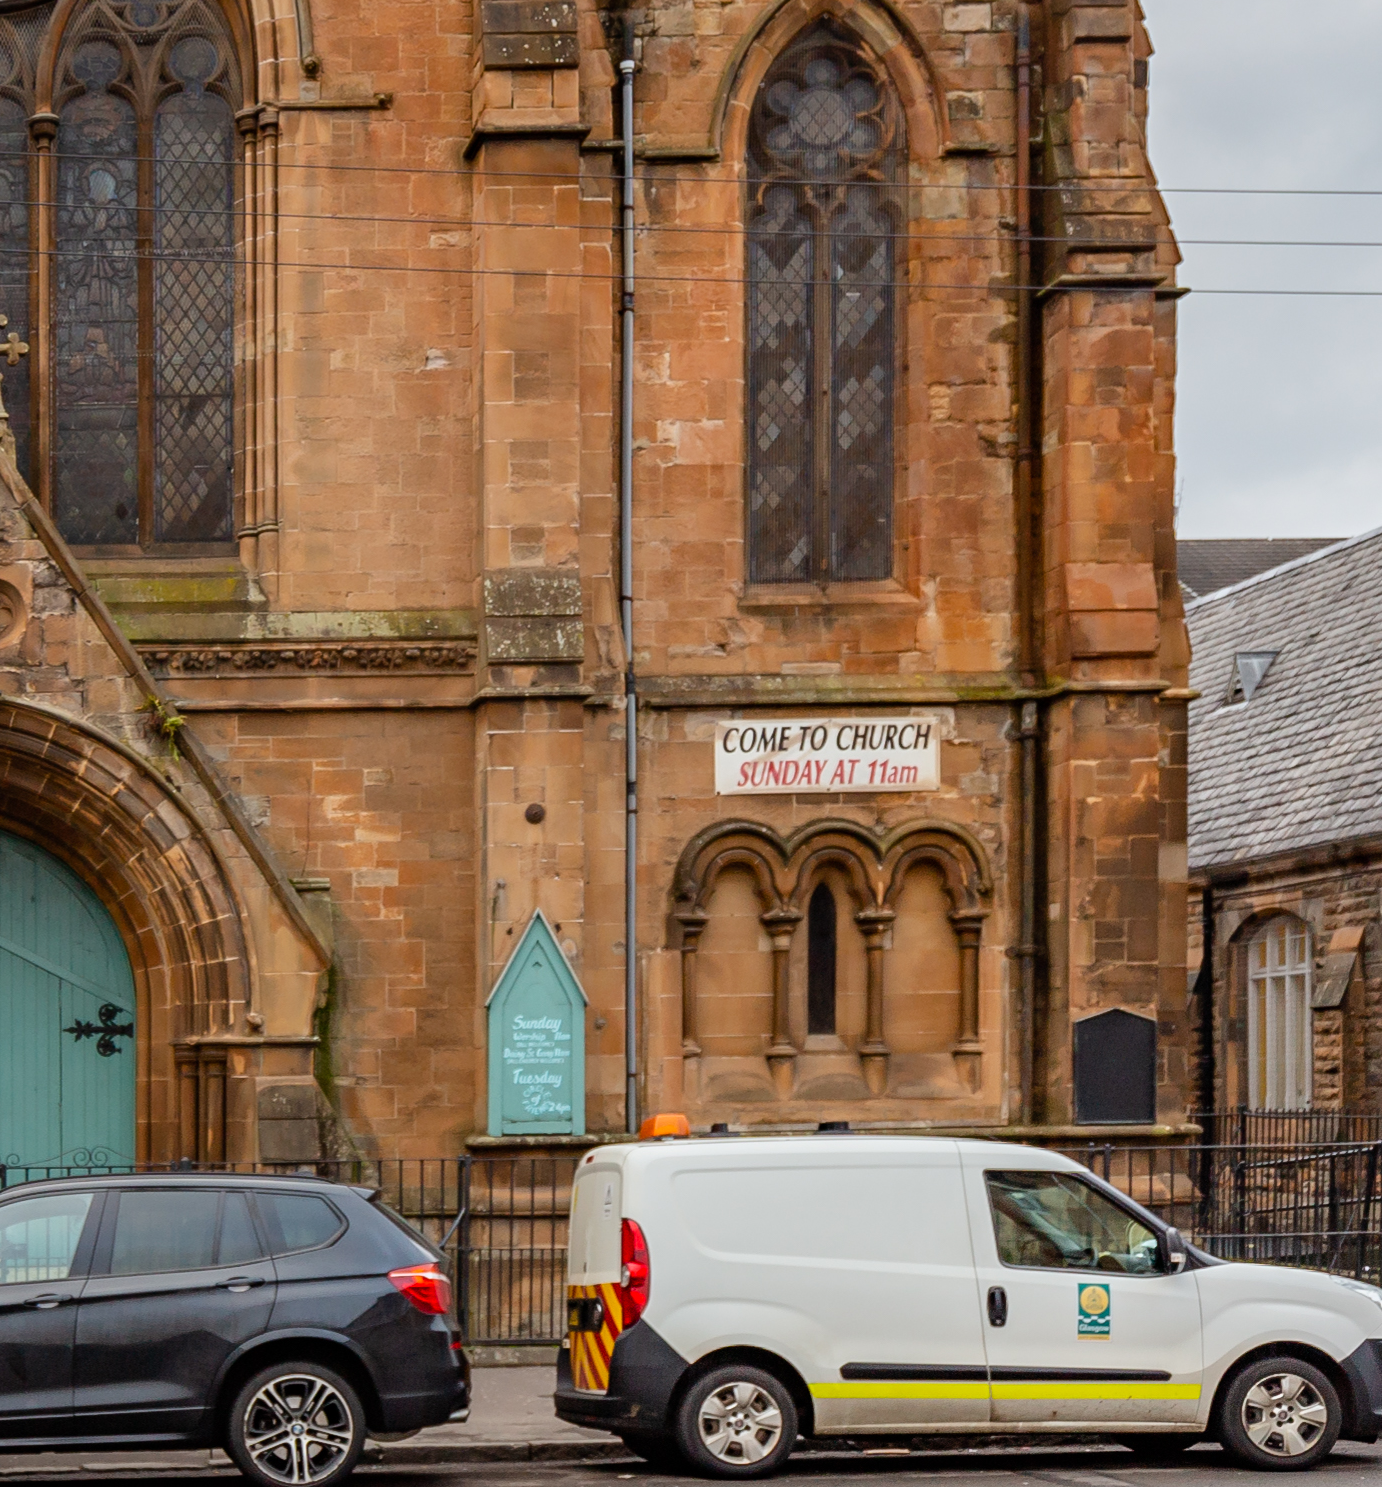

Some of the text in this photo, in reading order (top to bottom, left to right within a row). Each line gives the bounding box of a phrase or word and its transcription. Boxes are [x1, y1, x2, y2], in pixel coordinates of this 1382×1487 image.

[722, 724, 931, 753] COME TO CHURCH
[737, 759, 919, 787] SUNDAY AT 11am
[512, 1015, 562, 1033] Sunday
[512, 1068, 562, 1088] Tuesday
